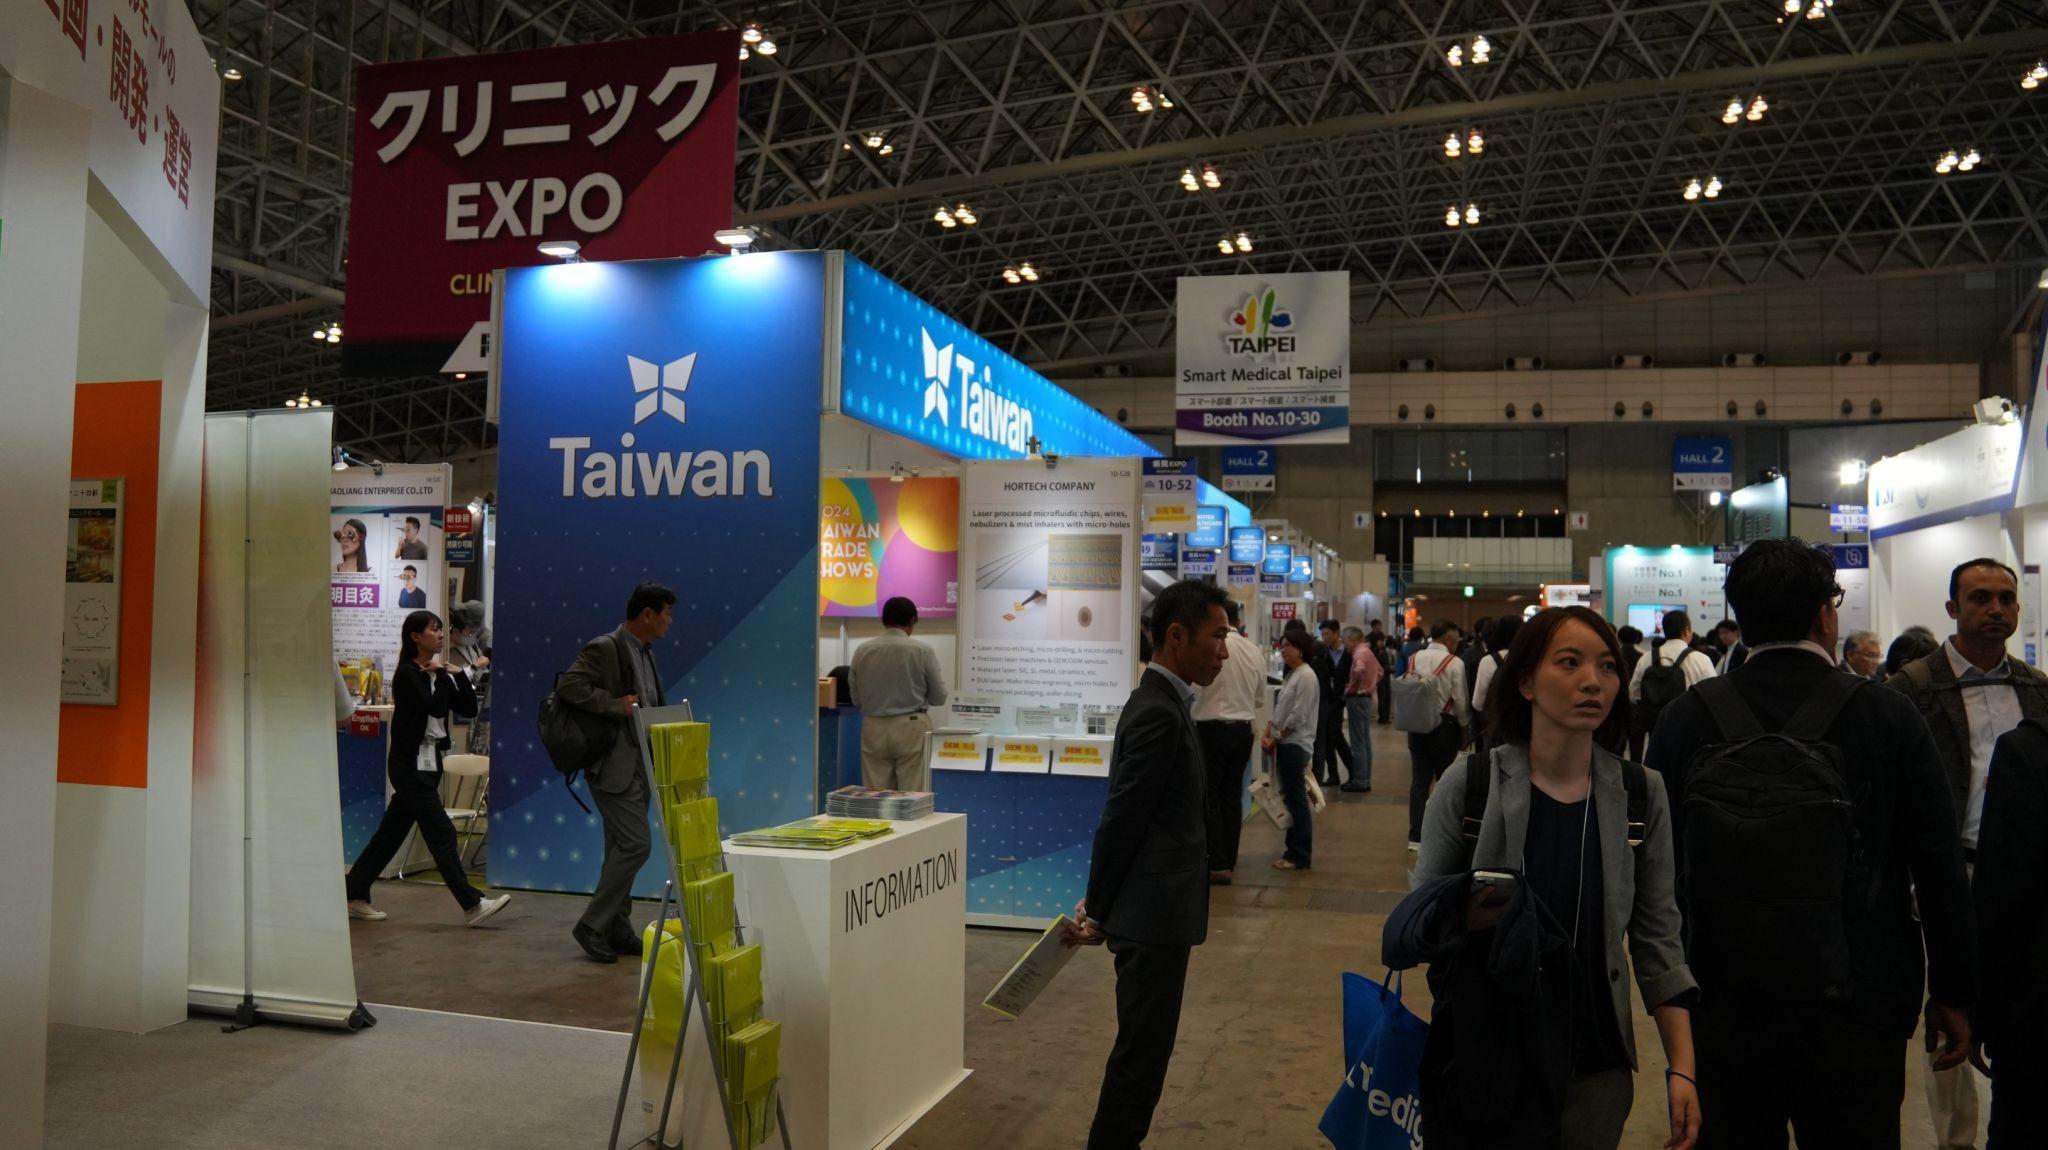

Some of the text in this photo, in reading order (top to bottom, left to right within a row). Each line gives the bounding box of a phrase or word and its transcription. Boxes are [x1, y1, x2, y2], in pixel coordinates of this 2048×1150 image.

[370, 62, 717, 164] クリニック
[445, 172, 623, 241] EXPO
[1229, 336, 1296, 353] TAIPEI
[1183, 366, 1342, 383] Smart Medical Taipei
[955, 353, 1034, 454] Taiwan
[1203, 411, 1320, 426] Booth No.10-30
[1228, 450, 1268, 466] HALL 2
[1680, 447, 1724, 464] HALL 2
[549, 432, 773, 498] Taiwan
[364, 486, 405, 496] ENTERPRISE
[1004, 482, 1096, 491] HORTECH COMPANY
[1159, 479, 1192, 490] 10-52
[994, 510, 1032, 518] processed
[821, 523, 880, 539] AIWAN
[821, 542, 867, 558] RADE
[821, 562, 874, 578] HOWS
[1659, 569, 1682, 578] No.1
[1659, 587, 1682, 597] No.1
[352, 714, 379, 723] English
[844, 848, 958, 934] INFORMATION
